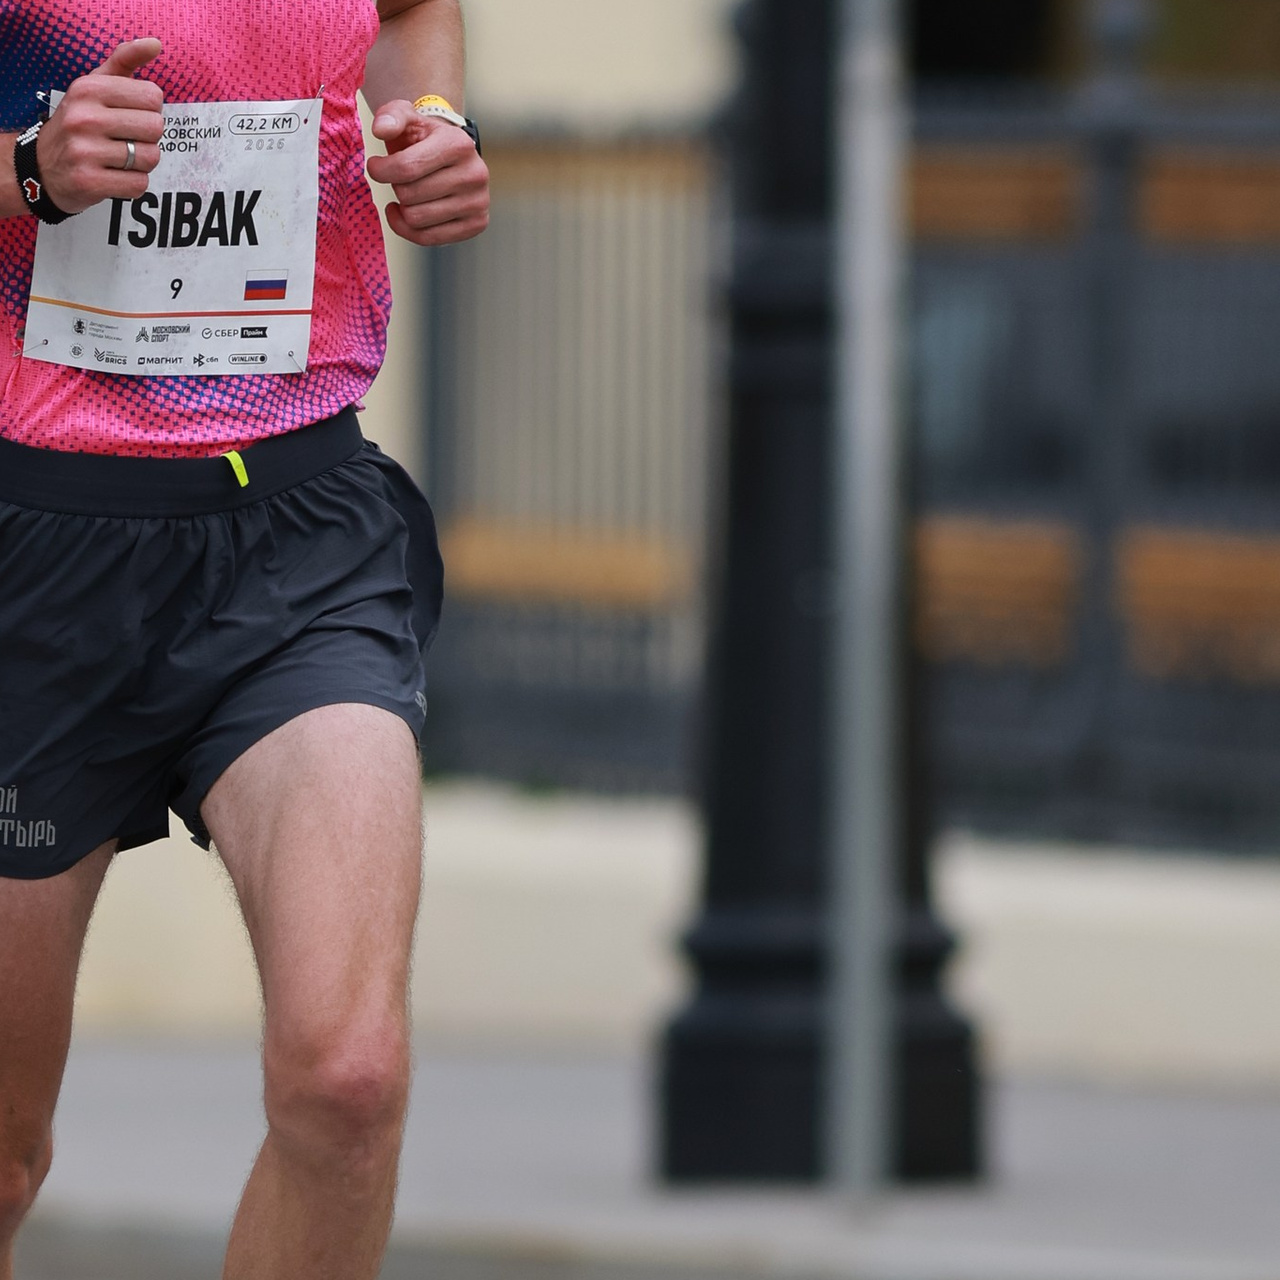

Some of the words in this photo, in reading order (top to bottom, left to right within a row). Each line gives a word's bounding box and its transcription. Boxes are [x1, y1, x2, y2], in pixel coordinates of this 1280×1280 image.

[236, 118, 268, 132] 42,2
[162, 125, 222, 139] КОВСКИЙ
[158, 141, 198, 152] АФОН
[244, 137, 285, 151] 2026
[108, 190, 262, 248] TSIBAK
[170, 278, 183, 300] 9
[152, 323, 191, 335] МОСКОВСКИЙ
[214, 328, 239, 338] СБЕР
[243, 329, 264, 337] Прайм
[151, 333, 170, 343] СПОРТ
[105, 357, 128, 366] BRICS
[231, 355, 259, 363] WINLINE
